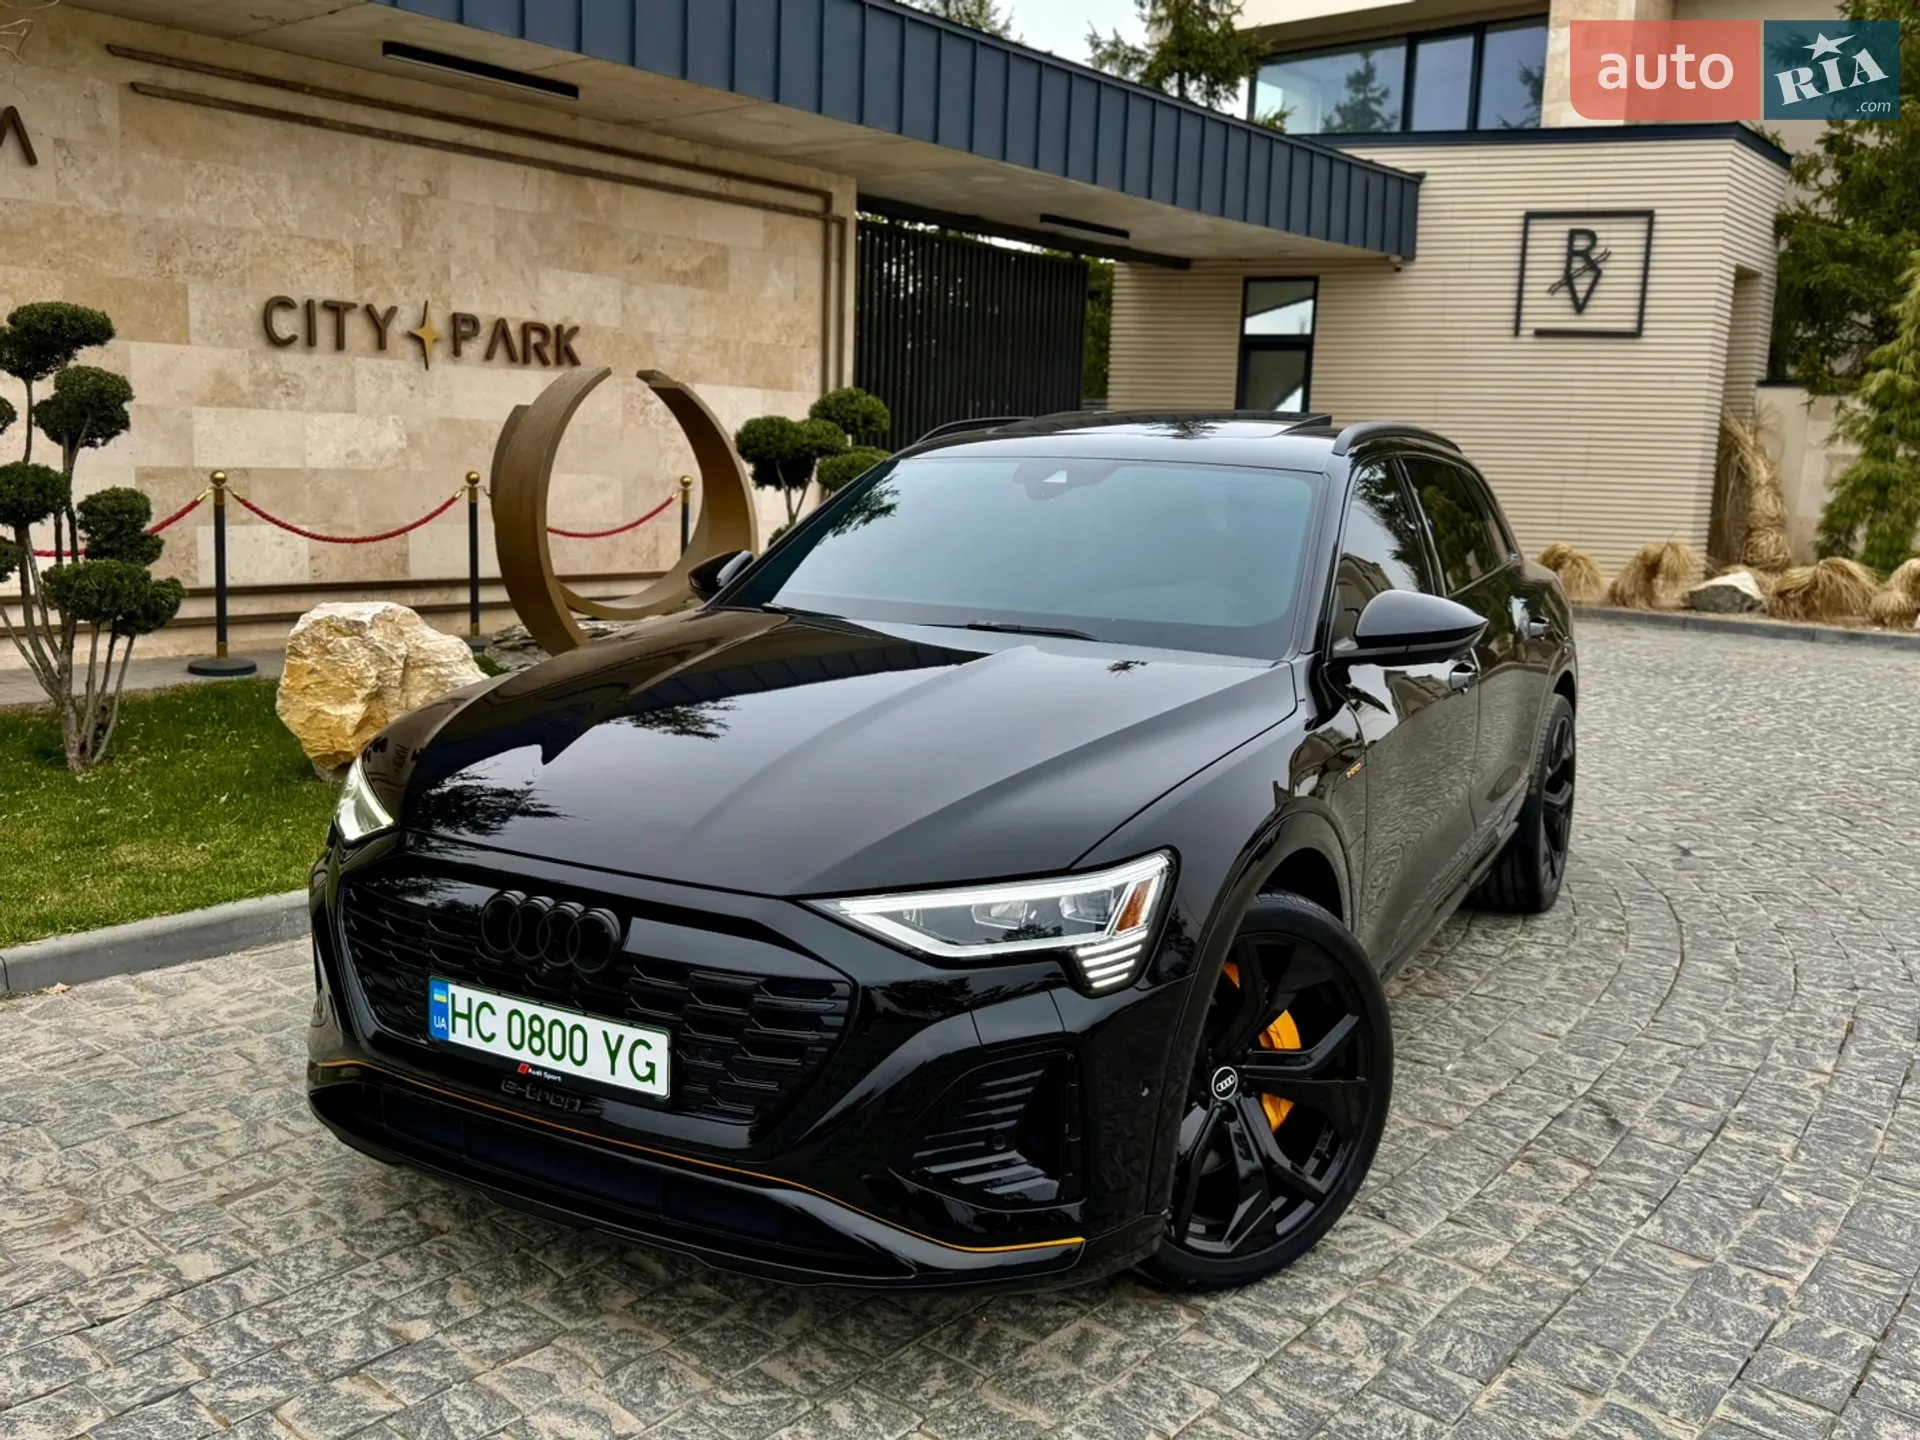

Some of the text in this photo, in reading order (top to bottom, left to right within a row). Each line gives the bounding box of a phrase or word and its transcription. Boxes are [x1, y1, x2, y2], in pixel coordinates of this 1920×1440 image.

[263, 295, 581, 367] CITY PARK
[433, 1015, 447, 1030] UA
[450, 993, 656, 1085] HC 0800 YG
